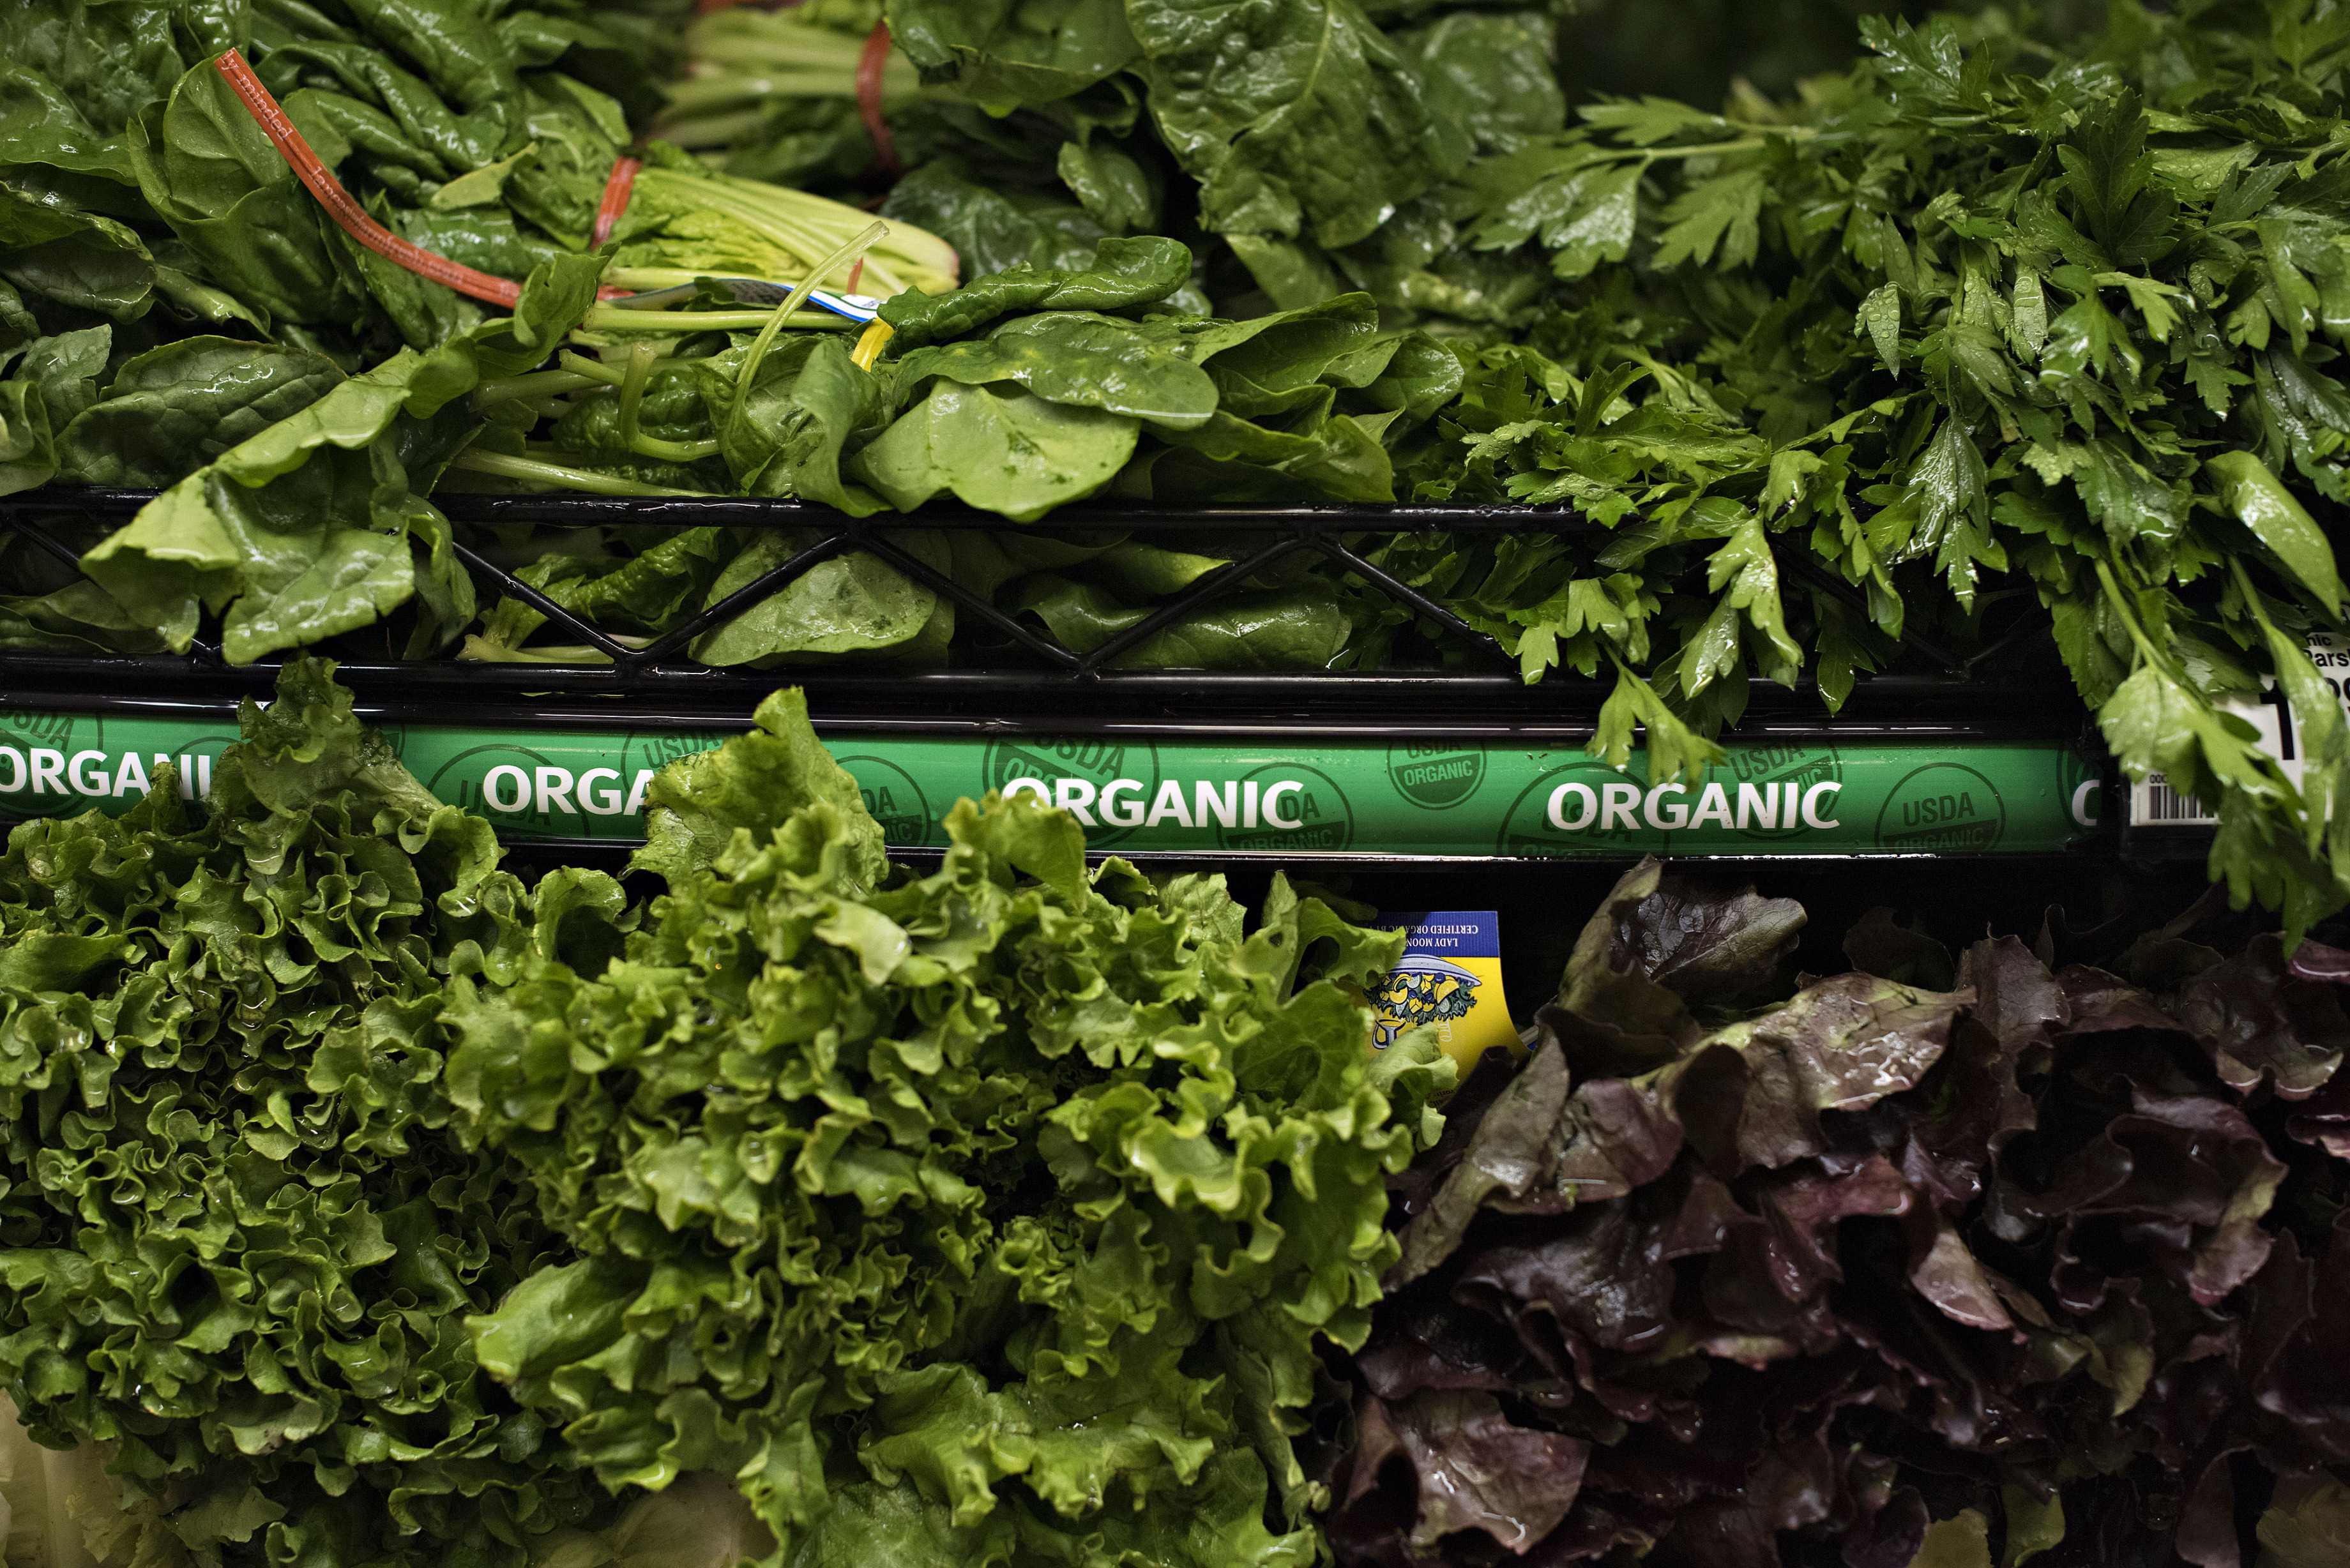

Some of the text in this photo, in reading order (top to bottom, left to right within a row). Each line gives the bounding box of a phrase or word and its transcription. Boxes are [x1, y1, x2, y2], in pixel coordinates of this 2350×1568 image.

[237, 75, 293, 141] minded
[2306, 634, 2332, 646] nic
[0, 746, 211, 799] ORGANI
[1404, 760, 1473, 787] ORGANIC
[483, 765, 655, 816] ORGA
[1547, 781, 1843, 830] ORGANIC
[1902, 792, 1975, 827] USDA
[1389, 925, 1429, 934] ORGAIC
[1406, 938, 1459, 947] LADY MOON
[1430, 924, 1479, 935] CERTIFIED
